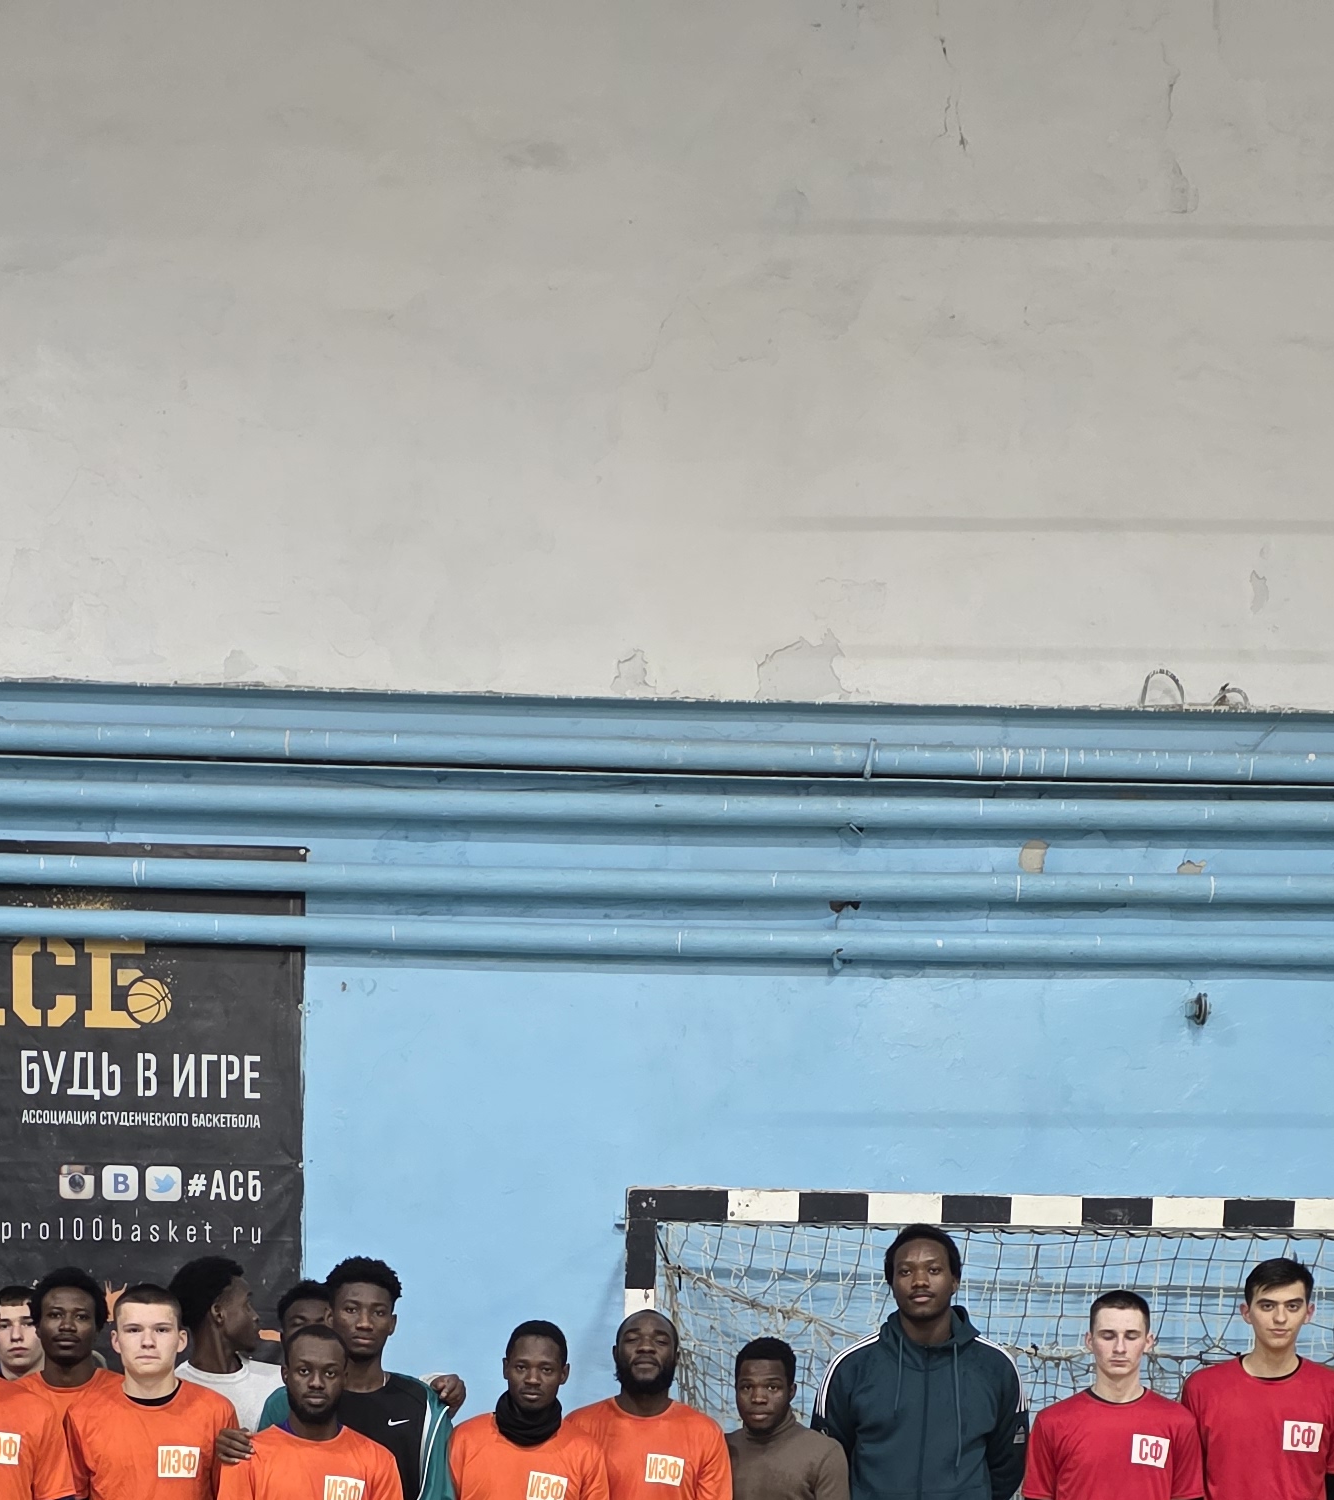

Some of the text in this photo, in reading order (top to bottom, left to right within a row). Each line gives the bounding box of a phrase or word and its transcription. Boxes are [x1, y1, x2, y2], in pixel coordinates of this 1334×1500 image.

[20, 1050, 261, 1100] БУДЬ В ИГРЕ
[21, 1109, 261, 1129] АССОЦИАЦИЯ СТУДЕНЧЕСКОГО БАСКЕТБОЛА
[187, 1170, 262, 1201] #АСБ
[1290, 1424, 1316, 1448] СФ
[161, 1449, 197, 1474] ИЭФ
[1139, 1438, 1163, 1462] СФ
[647, 1456, 681, 1481] ИЭФ
